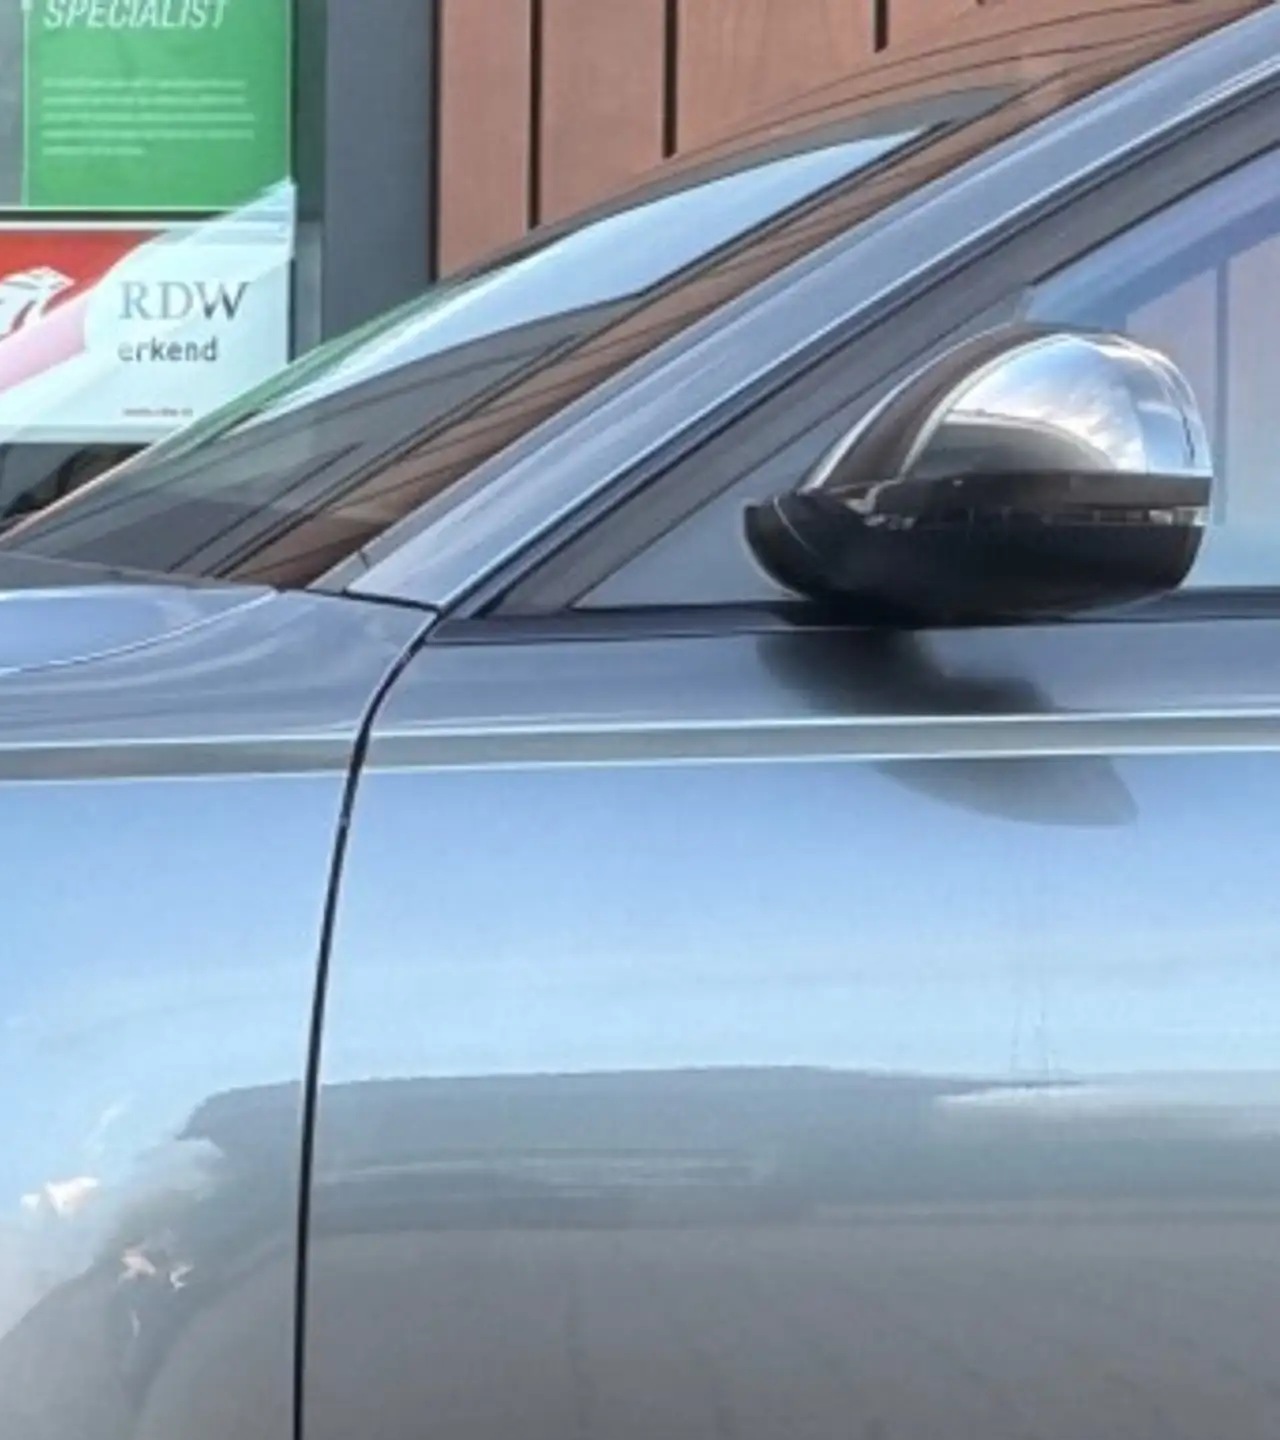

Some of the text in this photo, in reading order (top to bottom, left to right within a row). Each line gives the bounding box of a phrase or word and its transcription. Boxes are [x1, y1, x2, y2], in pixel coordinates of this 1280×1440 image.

[43, 0, 227, 29] SPECIALIST
[118, 281, 250, 321] RDW
[117, 336, 219, 363] erkend
